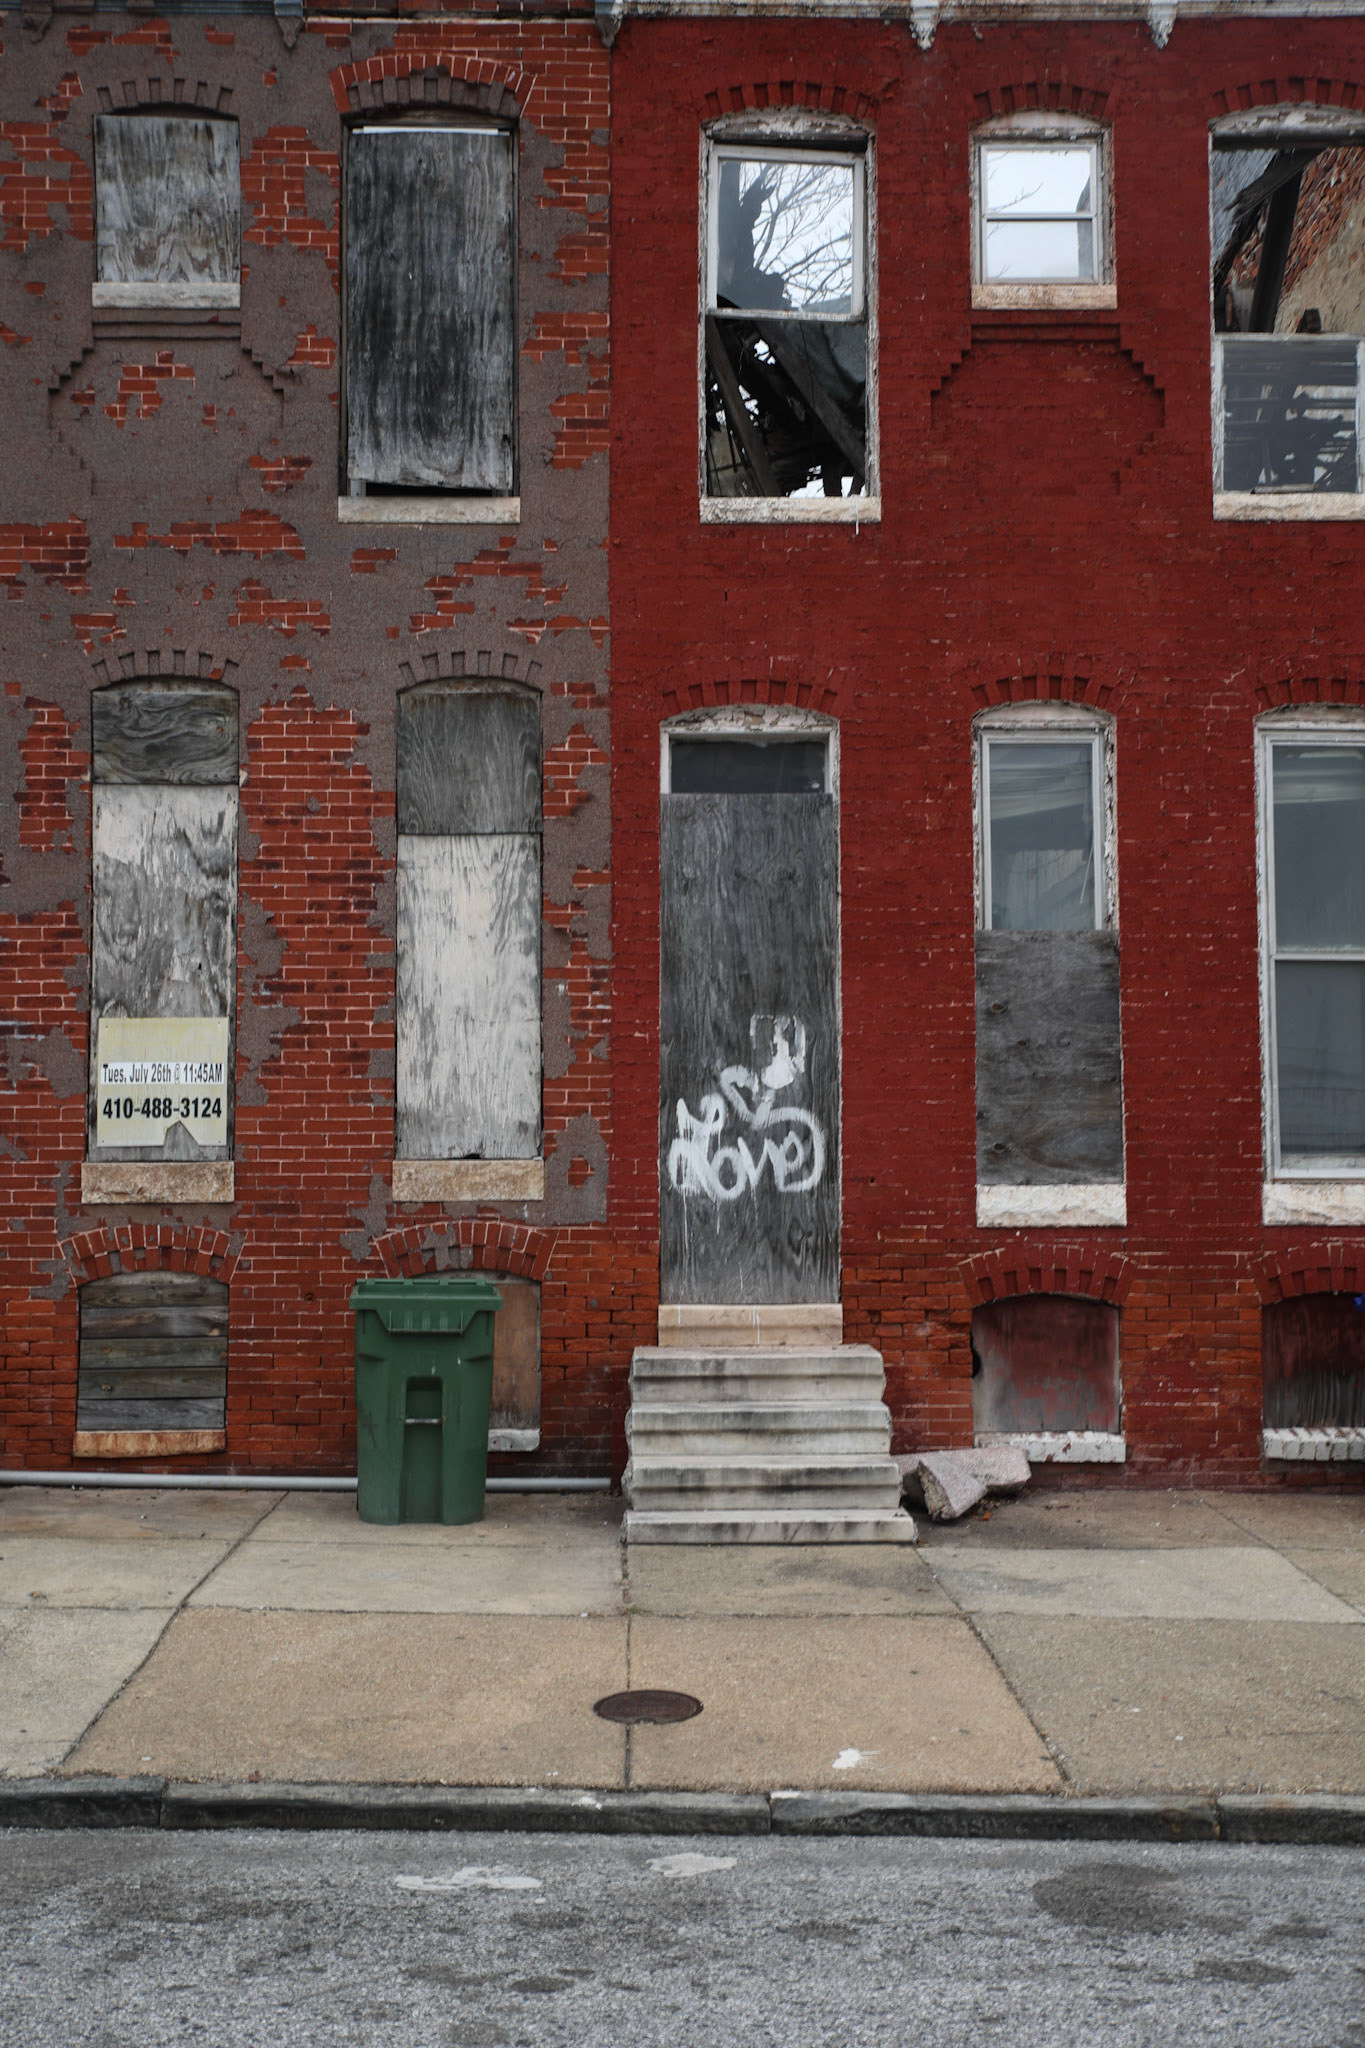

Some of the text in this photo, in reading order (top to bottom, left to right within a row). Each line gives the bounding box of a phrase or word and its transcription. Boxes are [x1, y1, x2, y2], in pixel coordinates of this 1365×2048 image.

[129, 1063, 149, 1084] July
[151, 1063, 172, 1082] 26th
[174, 1063, 181, 1084] @
[183, 1063, 223, 1082] 11:45AM
[102, 1097, 222, 1119] 410-488-3124
